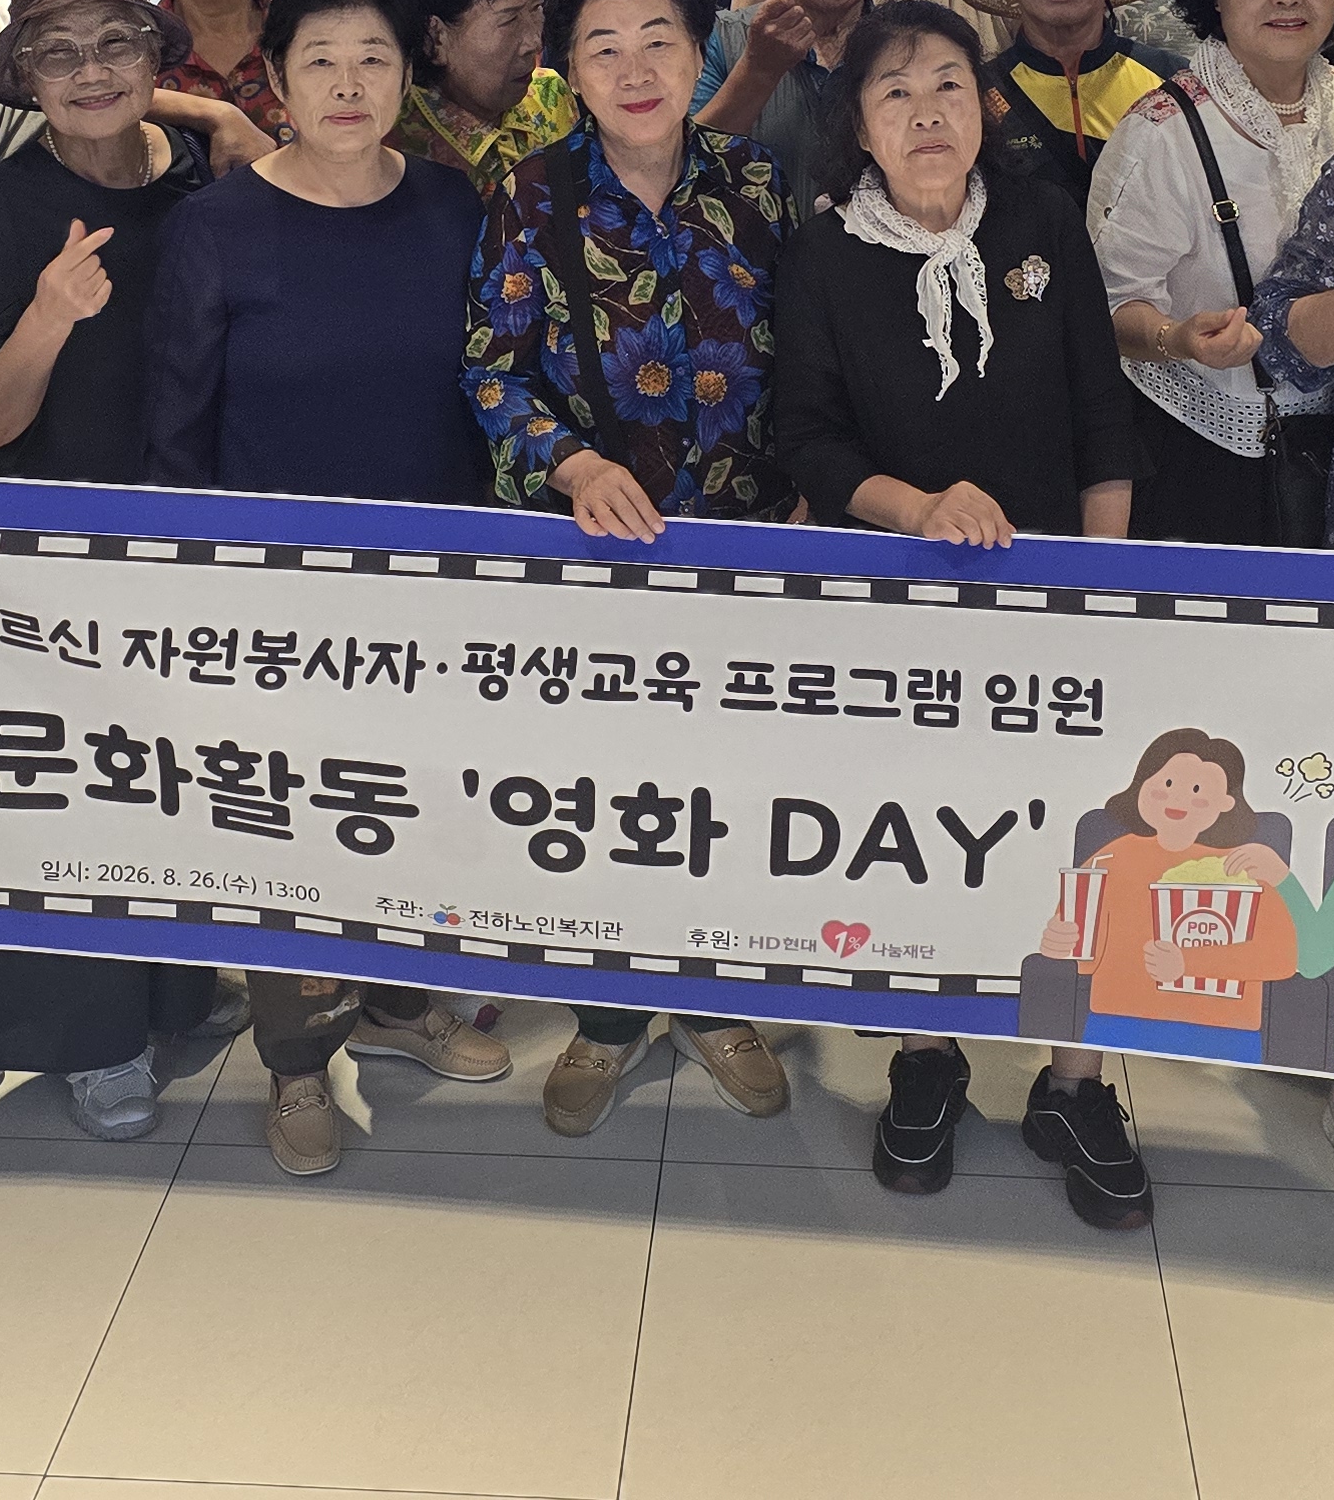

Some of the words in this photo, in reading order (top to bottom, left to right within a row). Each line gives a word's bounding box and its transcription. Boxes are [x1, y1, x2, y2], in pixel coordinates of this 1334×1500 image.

[719, 662, 962, 729] 프로그램
[985, 674, 1105, 737] 임원
[462, 768, 729, 878] '영화
[769, 797, 1046, 889] DAY'
[40, 860, 91, 884] 일시:
[97, 864, 156, 886] 2026.
[162, 868, 182, 887] 8.
[189, 870, 258, 897] 26.(수)
[264, 880, 321, 903] 13:00
[375, 896, 424, 919] 주관:
[468, 909, 624, 942] 전하노인복지관
[1187, 921, 1219, 936] POP
[687, 928, 739, 951] 후원:
[871, 942, 936, 960] 나눔재단
